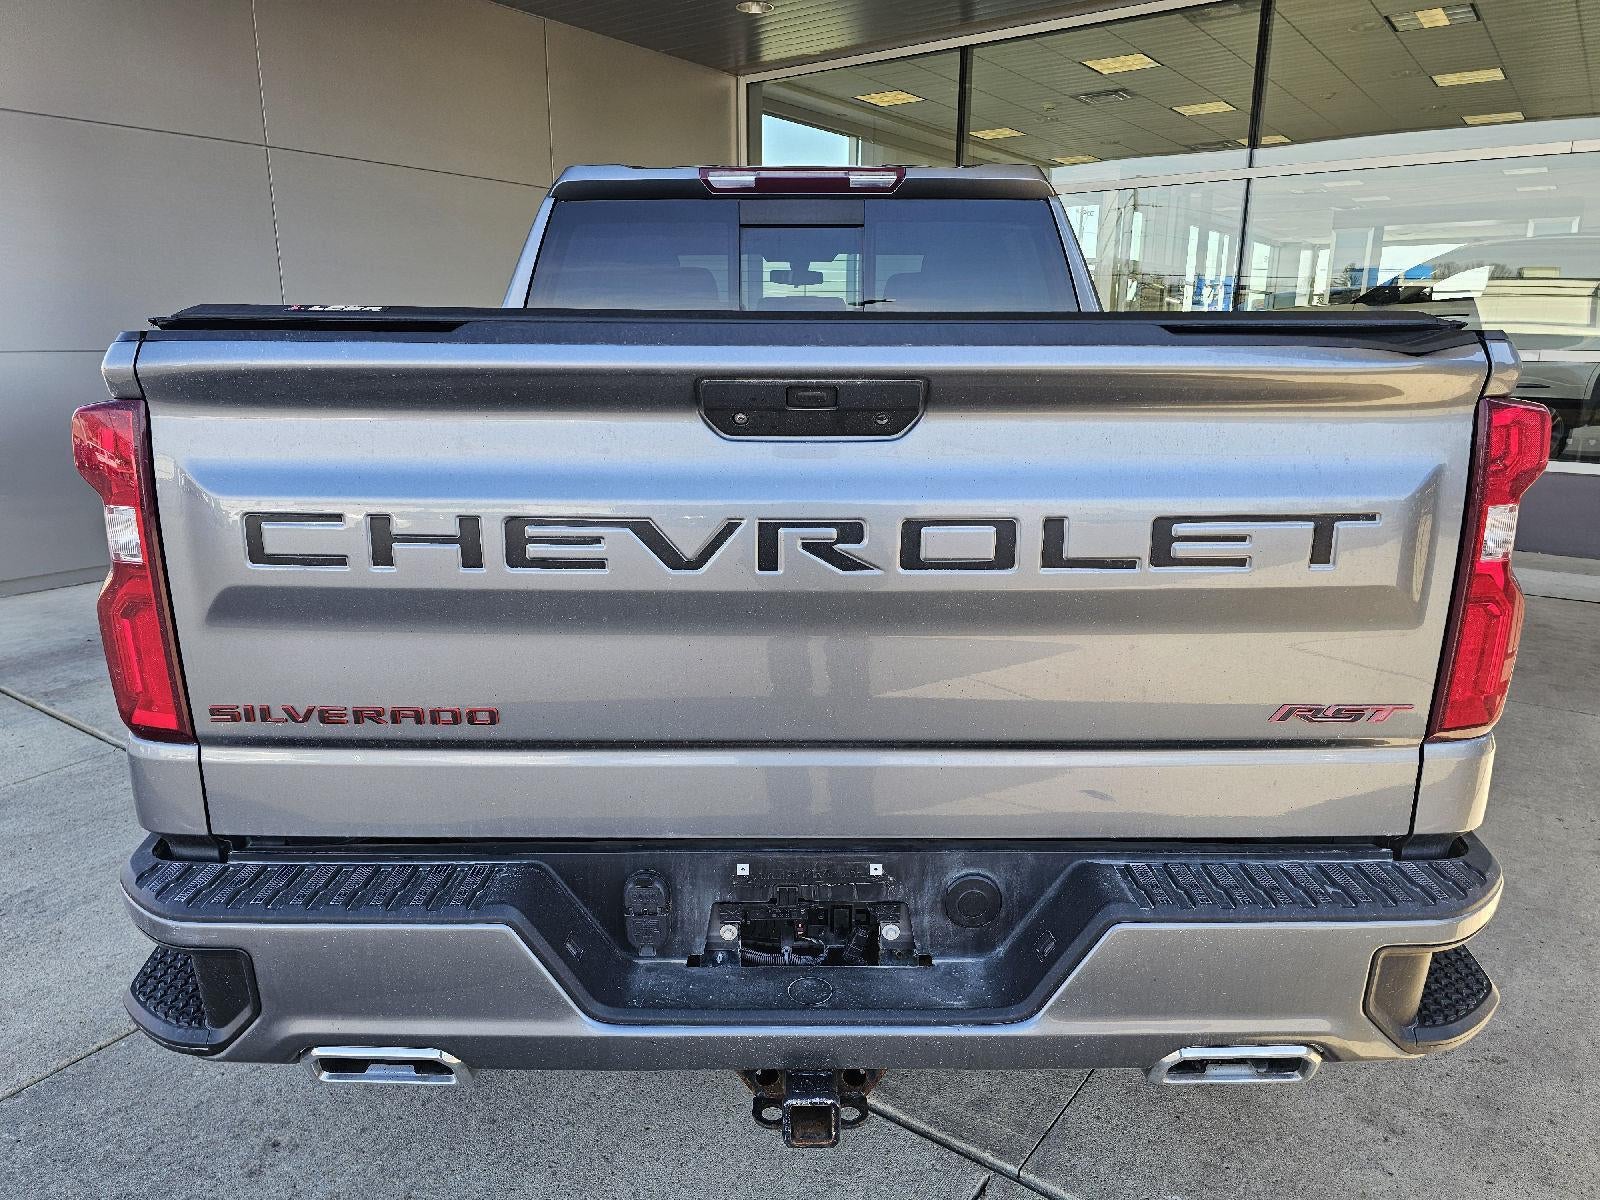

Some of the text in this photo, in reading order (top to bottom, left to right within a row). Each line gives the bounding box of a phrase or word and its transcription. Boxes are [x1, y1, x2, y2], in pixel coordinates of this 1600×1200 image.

[243, 512, 1380, 574] CHEVROLET
[208, 704, 499, 725] SILVERADO
[1268, 703, 1414, 722] RST
